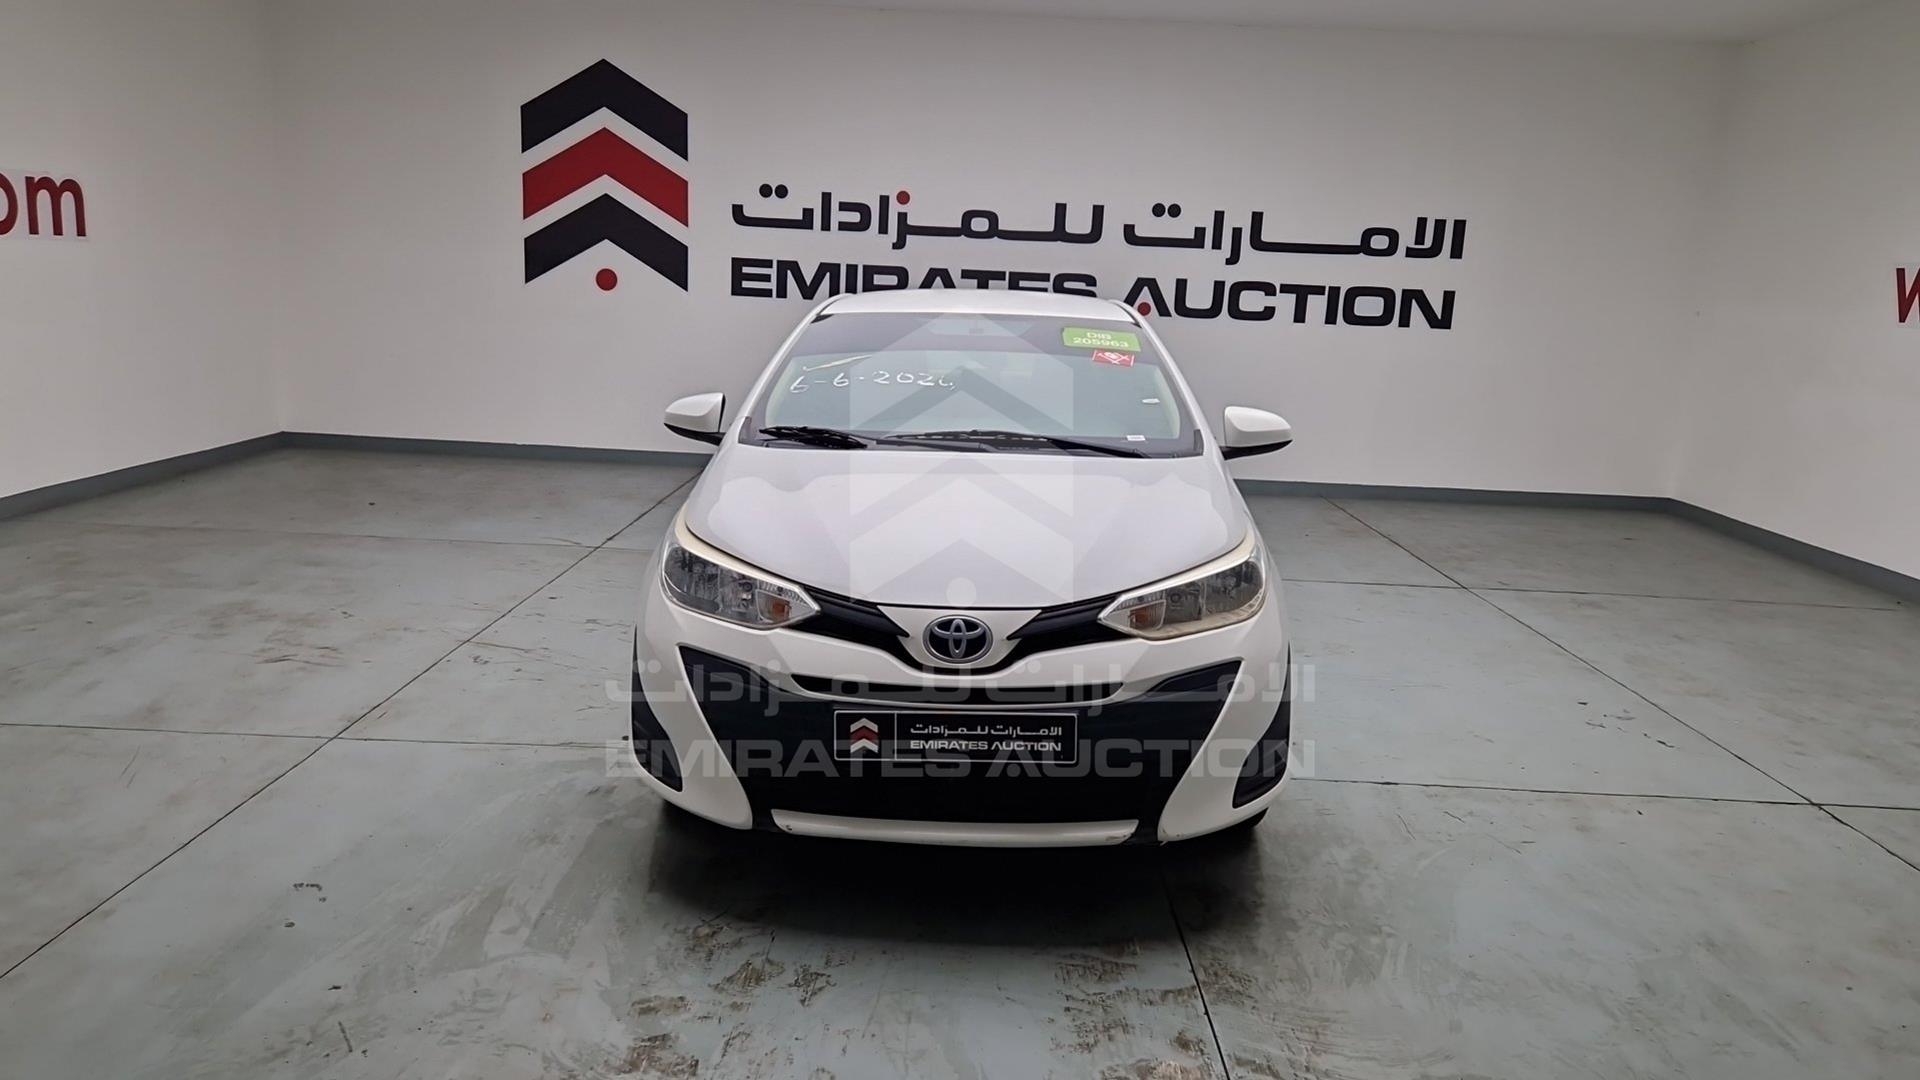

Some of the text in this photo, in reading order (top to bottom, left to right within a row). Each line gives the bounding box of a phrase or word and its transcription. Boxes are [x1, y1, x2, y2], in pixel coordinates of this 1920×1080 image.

[1124, 277, 1456, 329] AUCTION
[910, 739, 1062, 752] EMIRATES AUCTION
